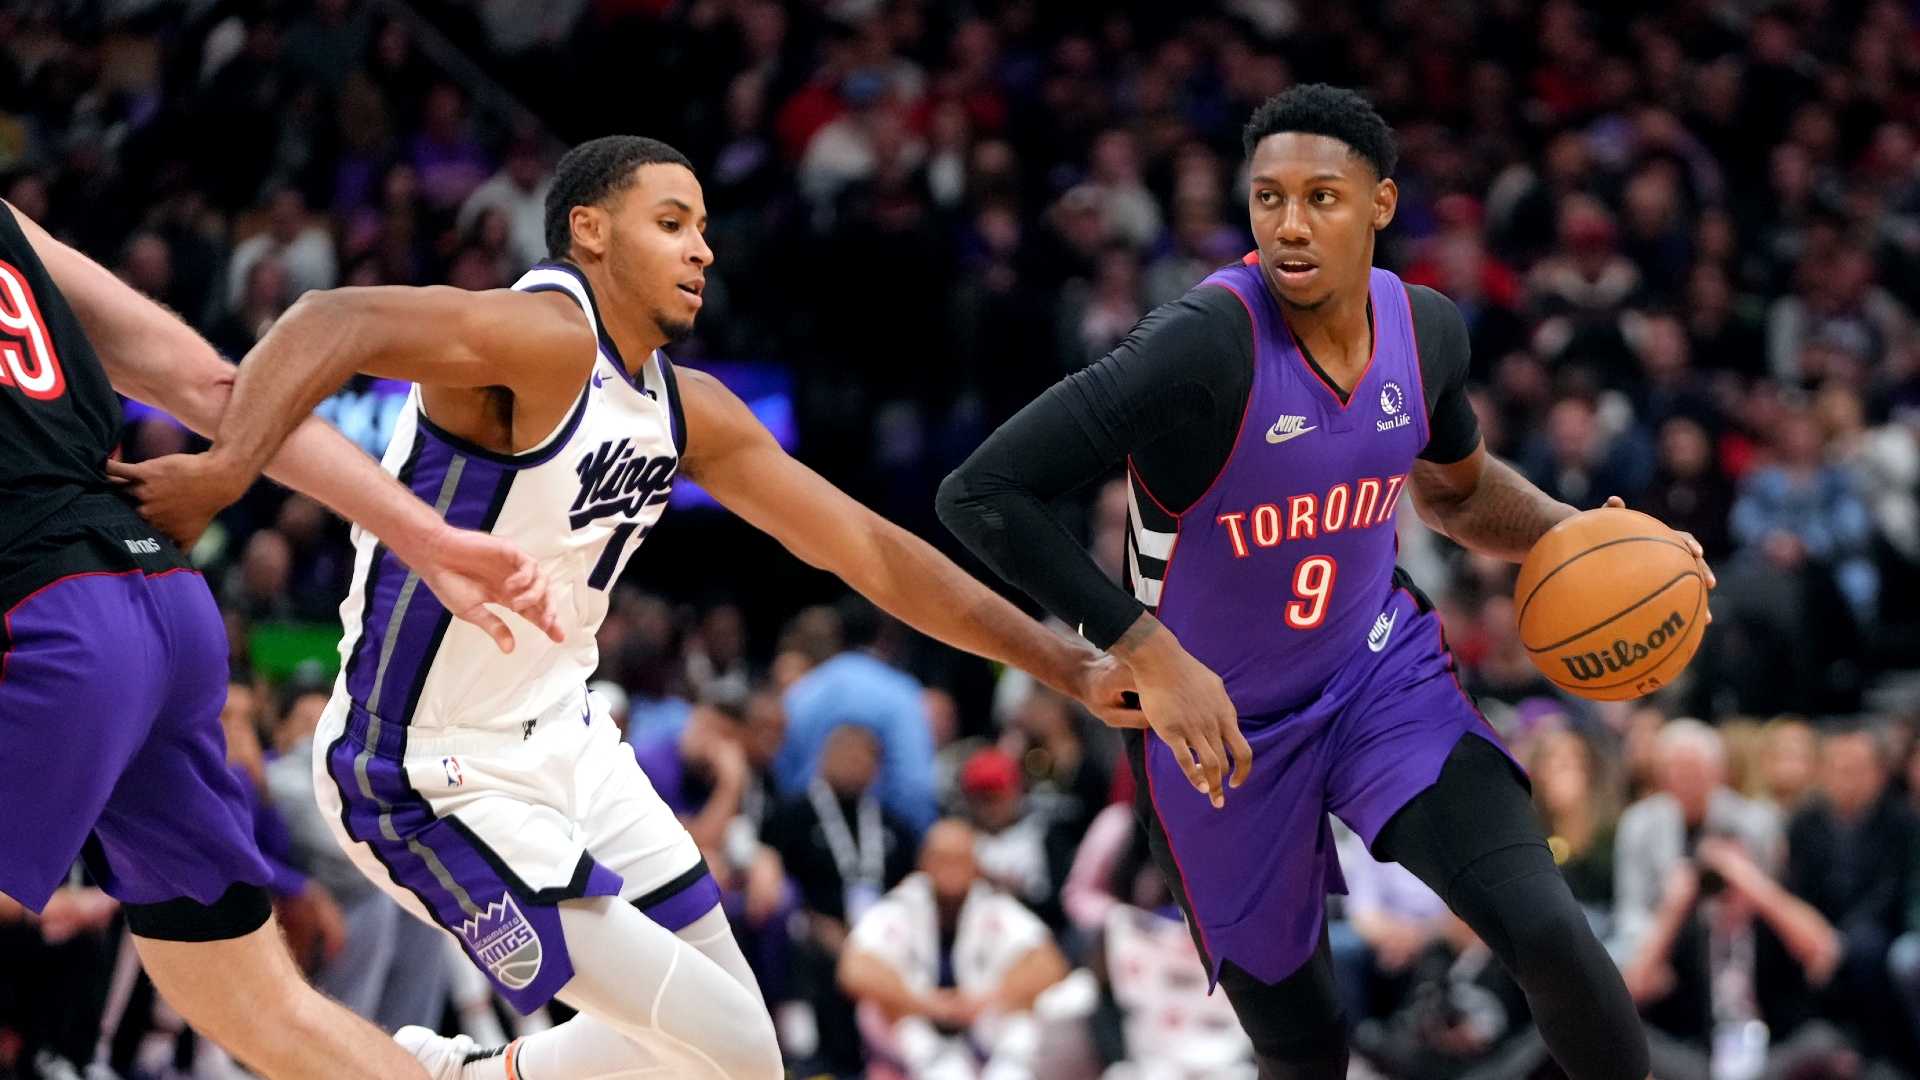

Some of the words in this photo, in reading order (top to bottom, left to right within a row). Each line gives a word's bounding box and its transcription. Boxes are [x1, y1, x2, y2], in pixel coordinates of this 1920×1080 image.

[0, 258, 66, 401] 9
[1274, 414, 1307, 433] NIKE
[1376, 419, 1393, 432] Sun
[1395, 413, 1411, 429] Life
[568, 437, 678, 519] King
[1216, 473, 1409, 558] TORONT
[587, 522, 655, 592] 1
[1284, 554, 1338, 631] 9
[1368, 612, 1390, 644] NIKE
[1560, 610, 1685, 682] Wilson
[480, 924, 534, 965] KINGS
